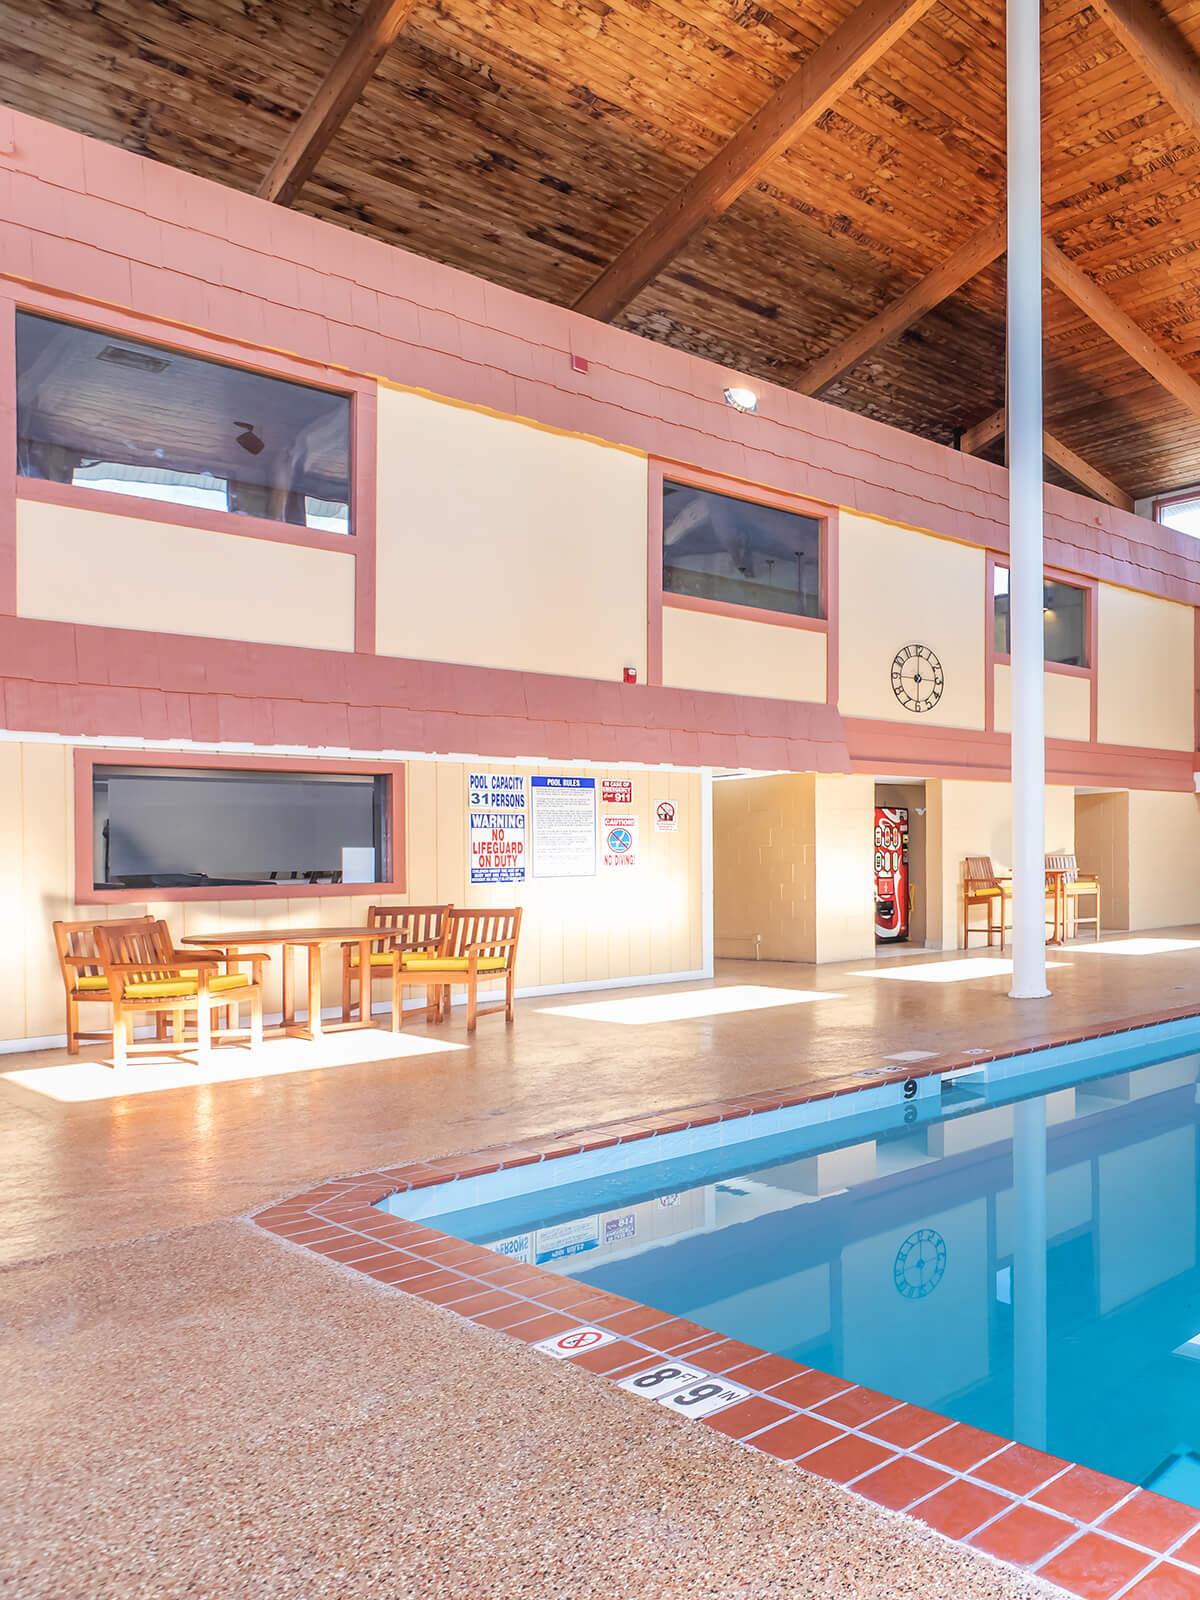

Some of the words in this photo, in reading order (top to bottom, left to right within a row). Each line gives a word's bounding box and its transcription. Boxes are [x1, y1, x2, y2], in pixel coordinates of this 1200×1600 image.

[470, 775, 488, 789] POOL
[491, 776, 524, 790] CAPACITY
[547, 778, 561, 786] POOL
[562, 779, 580, 787] RULES
[471, 793, 488, 804] 31
[491, 793, 525, 807] PERSONS
[615, 793, 630, 802] 911
[472, 814, 525, 828] WARNING
[492, 829, 504, 841] NO
[473, 842, 524, 854] LIFEGUARD
[479, 855, 491, 868] ON
[495, 855, 518, 868] DUTY
[604, 855, 612, 865] NO
[904, 1080, 918, 1098] 9
[633, 1368, 682, 1388] 8
[676, 1373, 698, 1383] FT
[673, 1384, 723, 1405] 9
[718, 1390, 740, 1401] IN
